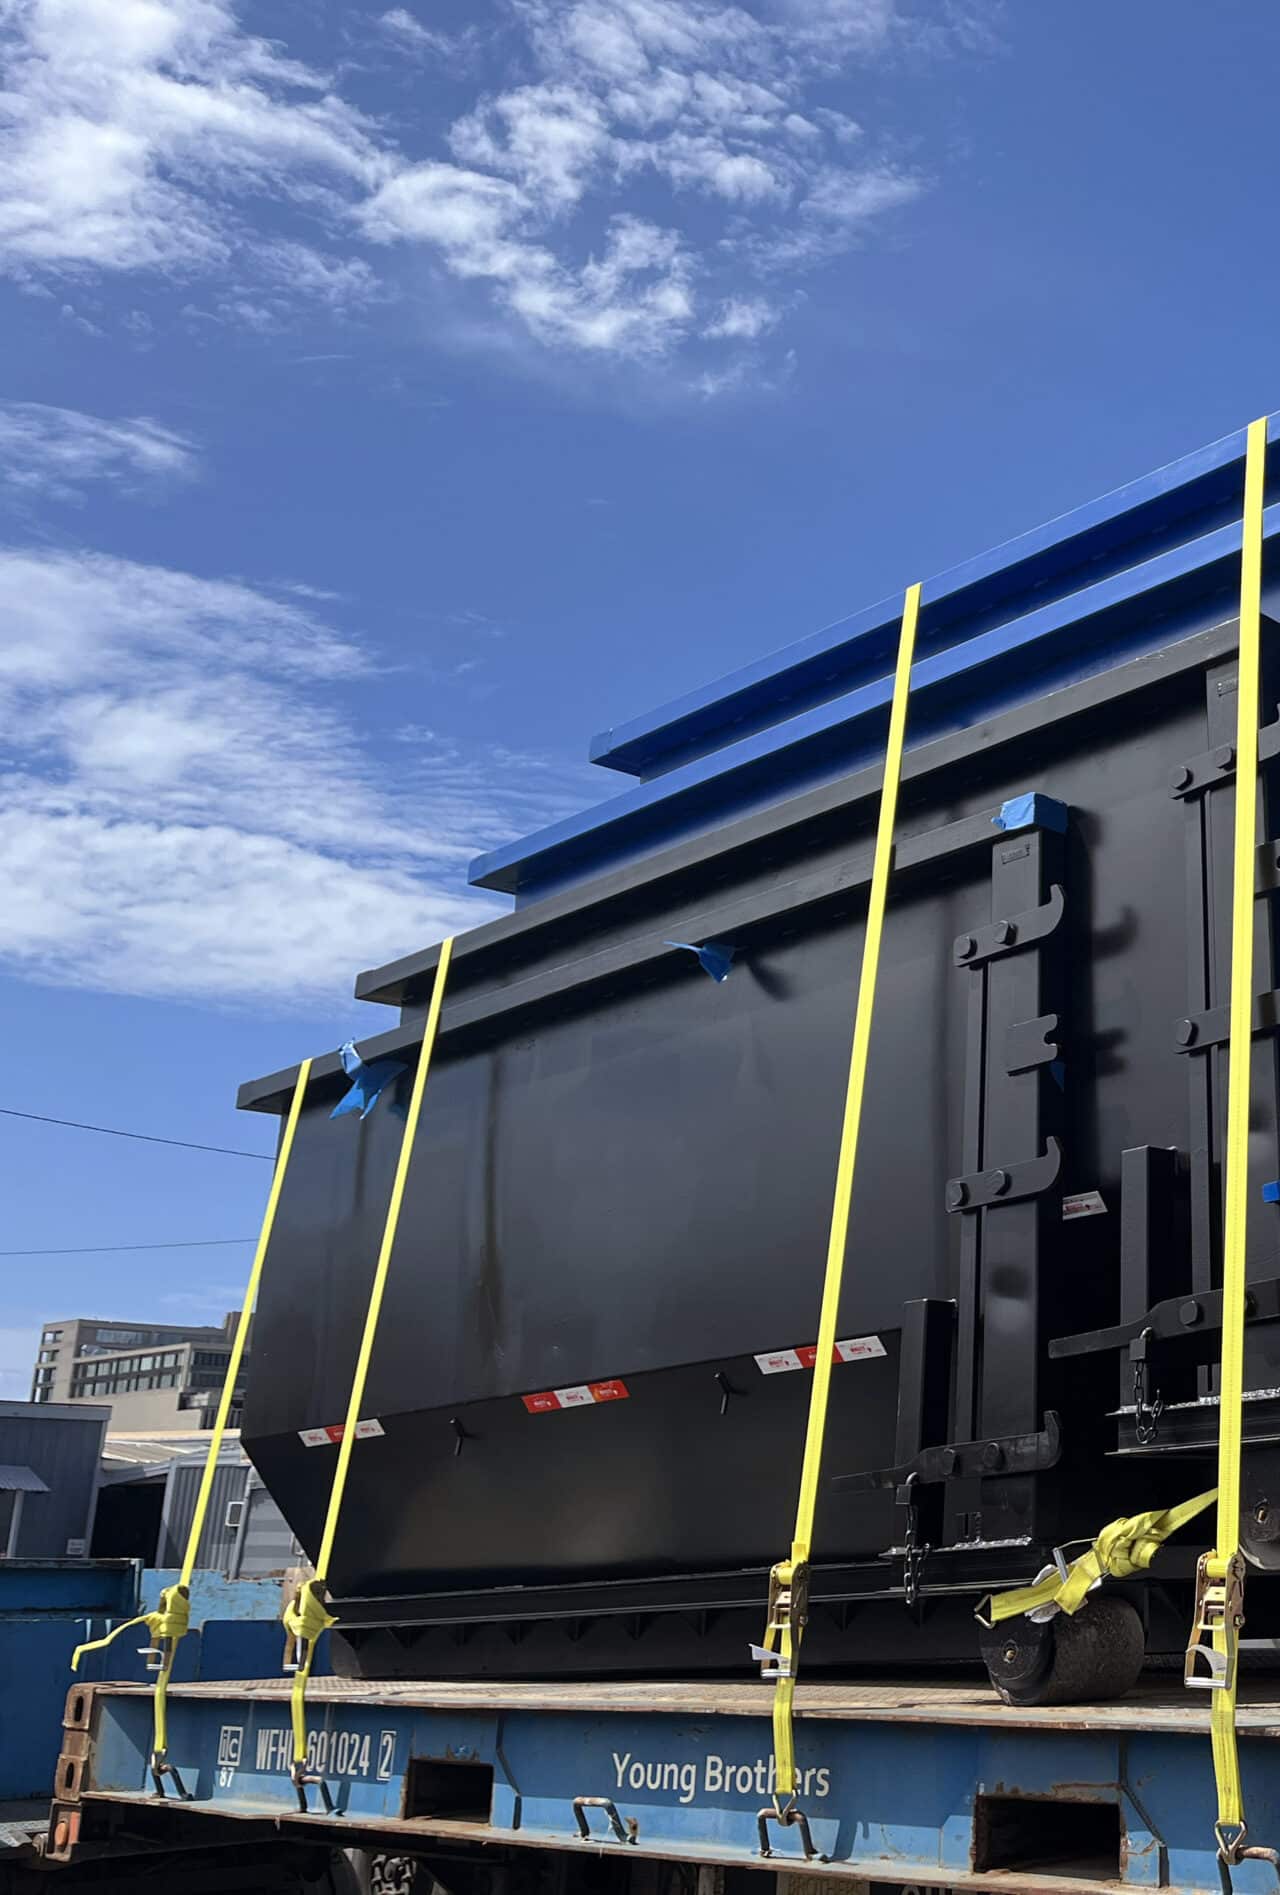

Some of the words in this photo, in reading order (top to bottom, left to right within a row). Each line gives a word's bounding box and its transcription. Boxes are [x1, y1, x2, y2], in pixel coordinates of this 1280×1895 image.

[219, 1767, 234, 1788] 87
[305, 1730, 372, 1777] 601024
[379, 1733, 393, 1778] 2
[612, 1752, 697, 1804] Young
[704, 1754, 831, 1797] Brothers
